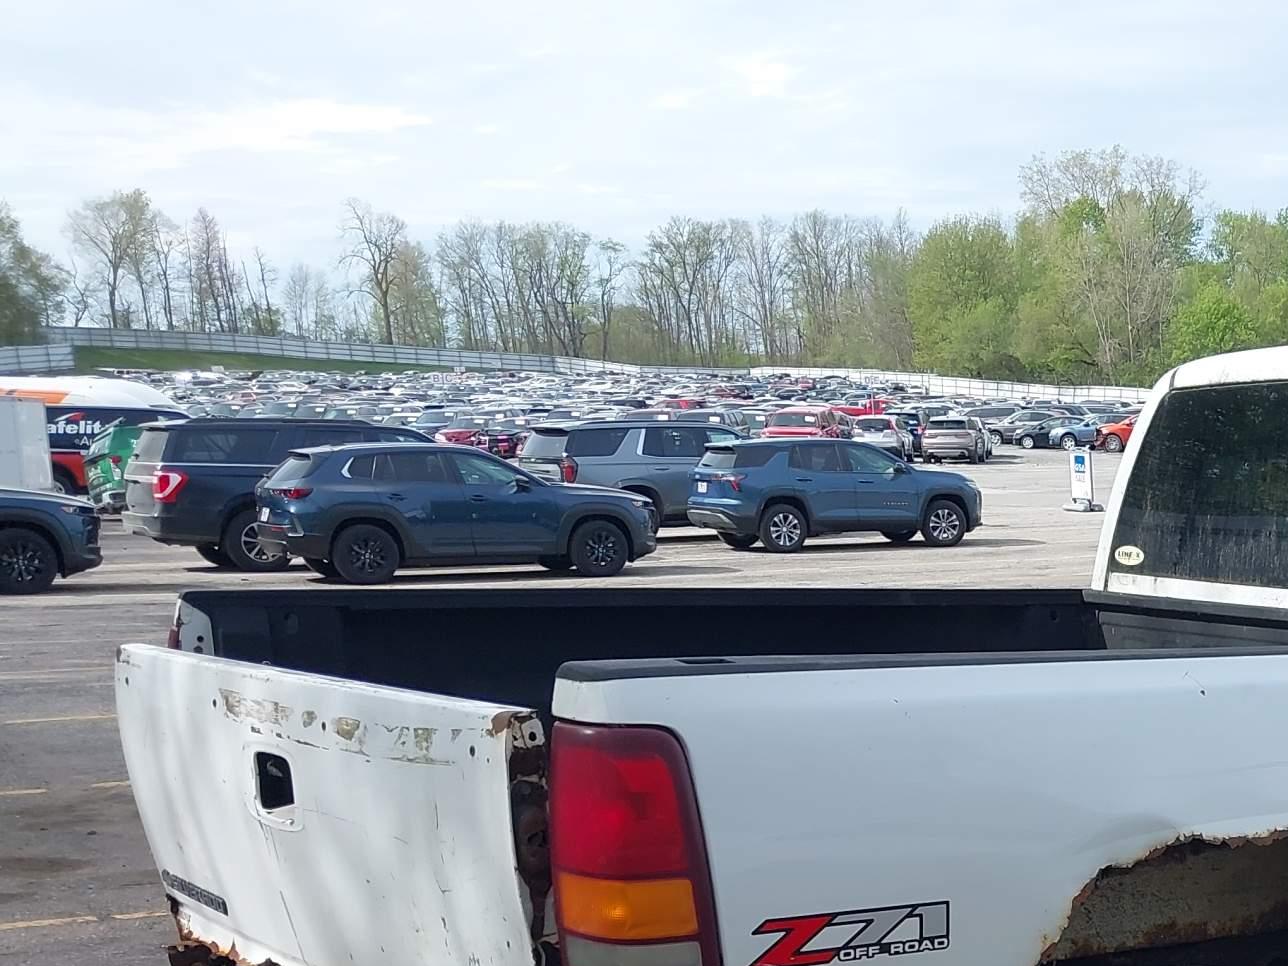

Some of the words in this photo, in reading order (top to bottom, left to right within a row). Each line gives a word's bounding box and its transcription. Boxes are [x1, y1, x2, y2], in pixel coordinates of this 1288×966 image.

[47, 420, 108, 435] afelit
[838, 945, 881, 962] OFF
[890, 936, 949, 955] ROAD
